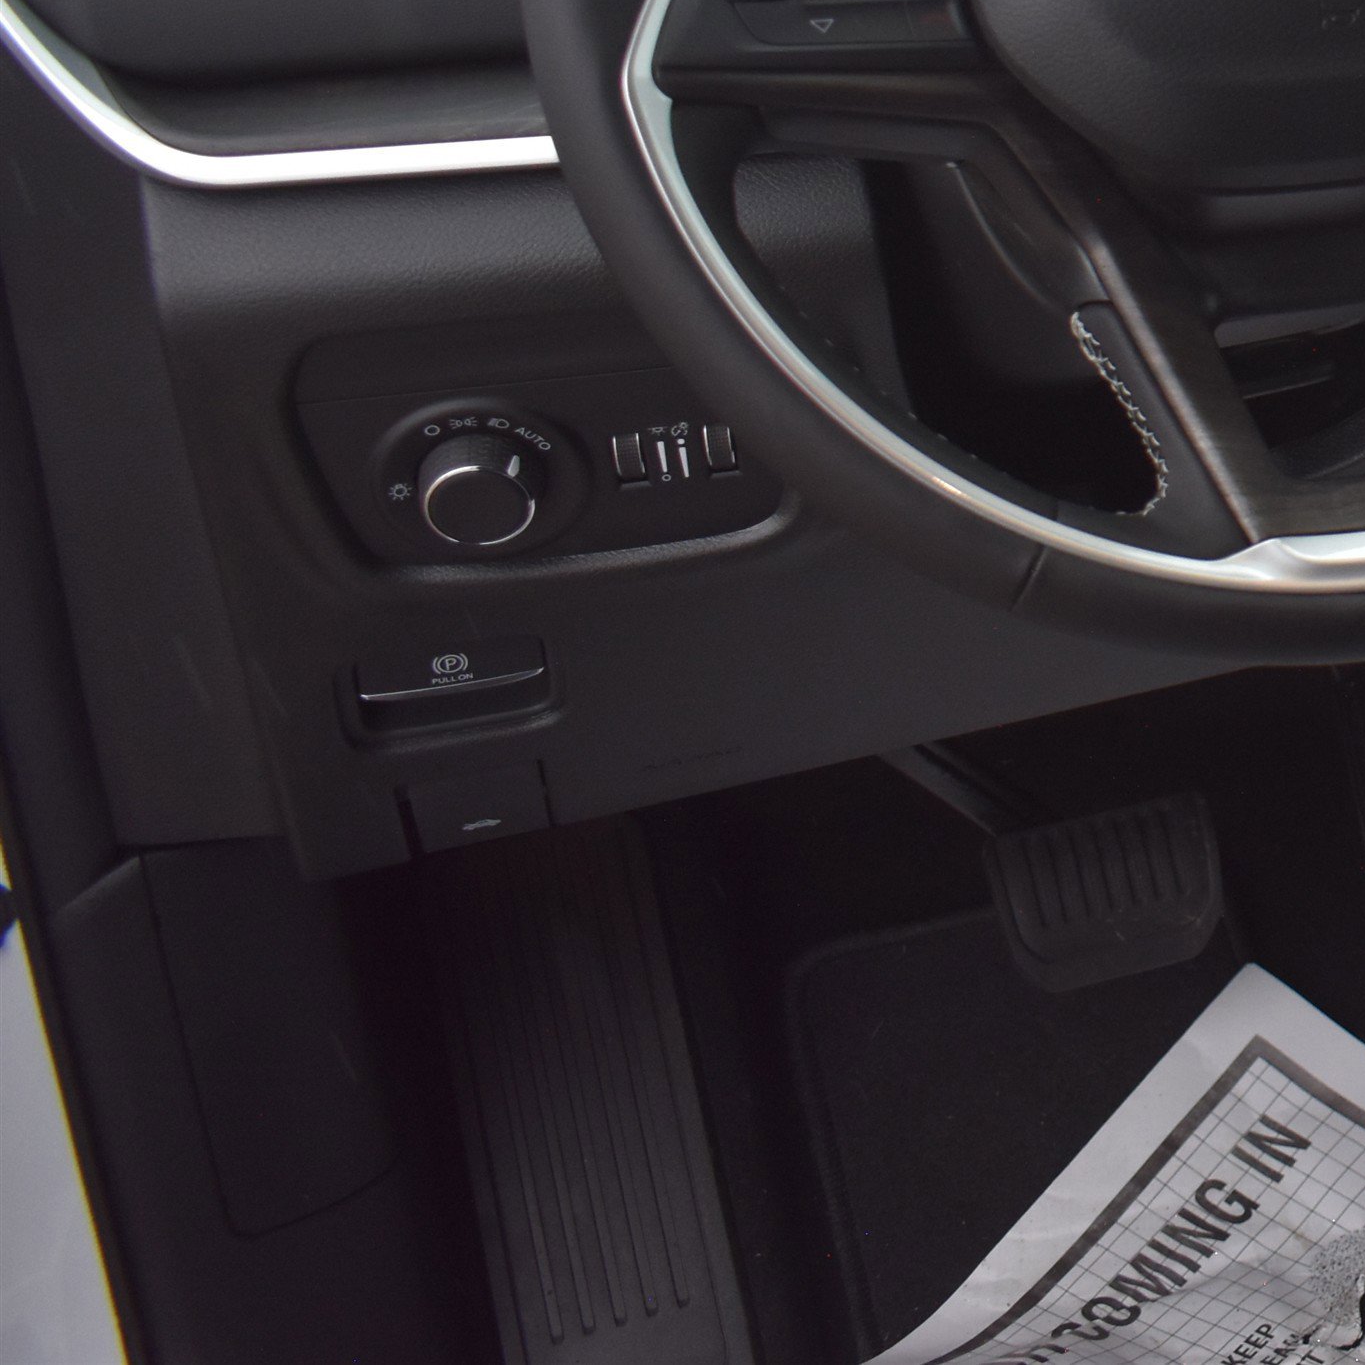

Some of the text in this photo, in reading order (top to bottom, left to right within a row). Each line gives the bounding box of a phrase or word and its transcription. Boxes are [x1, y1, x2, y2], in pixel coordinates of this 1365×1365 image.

[515, 426, 552, 451] AUTO
[432, 673, 474, 685] PULL ON
[1051, 1113, 1311, 1341] COMING IN
[1220, 1323, 1275, 1365] KEEP
